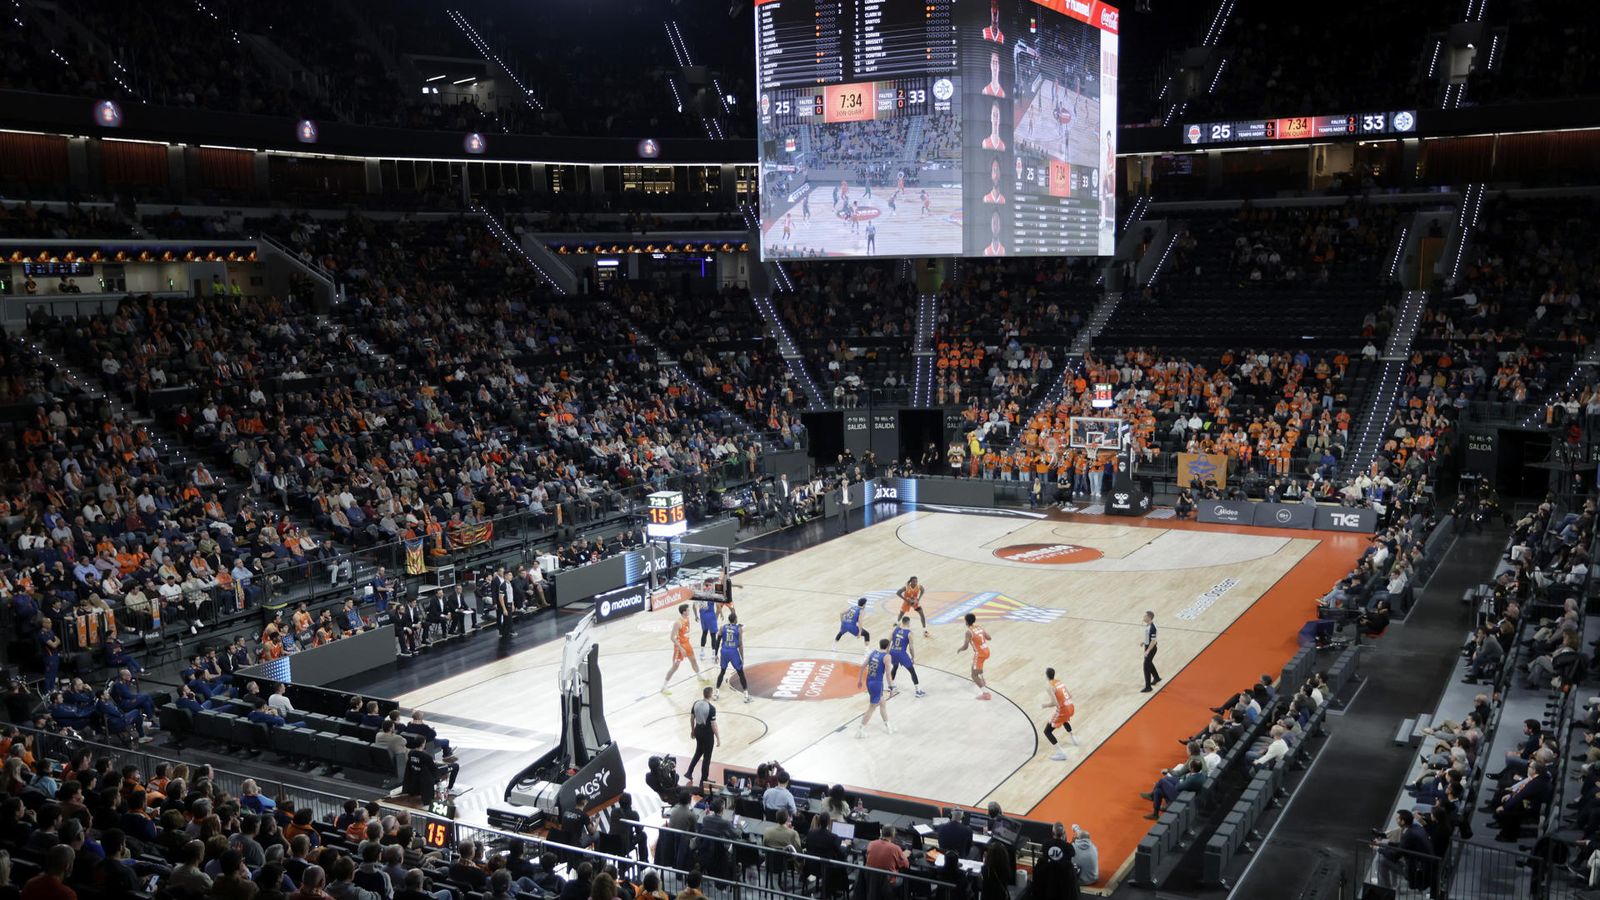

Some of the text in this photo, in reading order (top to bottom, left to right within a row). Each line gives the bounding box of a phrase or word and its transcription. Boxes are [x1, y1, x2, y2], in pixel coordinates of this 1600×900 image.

[840, 93, 862, 108] 7:34
[910, 90, 925, 103] 33
[776, 101, 790, 114] 25
[1288, 118, 1307, 131] 7:34
[1364, 116, 1383, 130] 33
[1212, 124, 1230, 139] 25
[1027, 168, 1034, 180] 25
[1082, 176, 1088, 188] 33
[1469, 443, 1492, 451] SALIDA
[650, 508, 668, 523] 15
[671, 506, 683, 522] 15
[1331, 513, 1360, 527] TKE
[612, 595, 642, 611] motorola
[575, 778, 600, 795] MGS
[428, 823, 445, 846] 15
